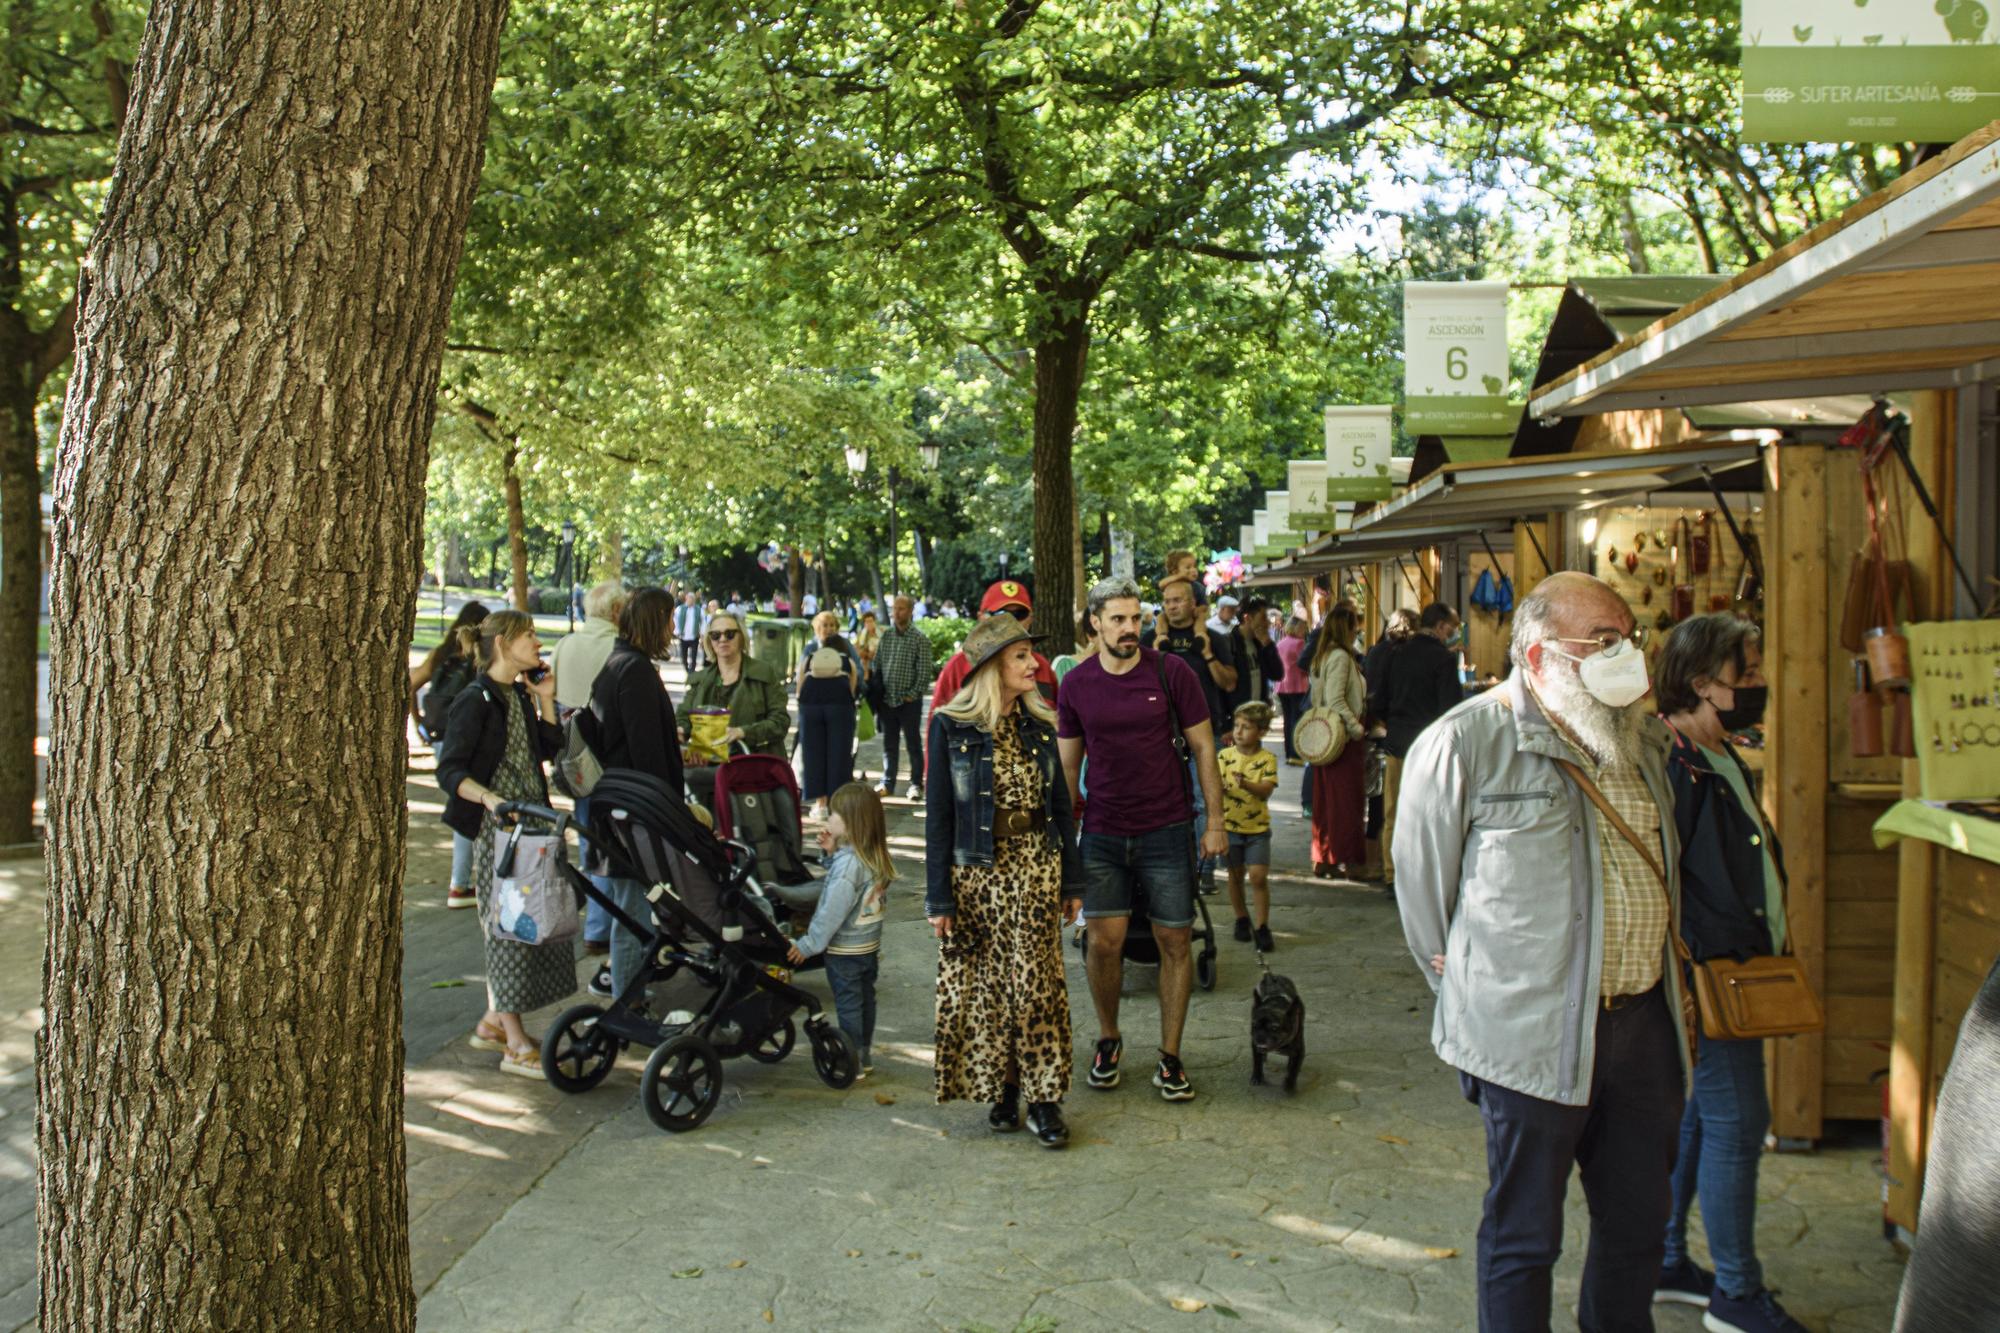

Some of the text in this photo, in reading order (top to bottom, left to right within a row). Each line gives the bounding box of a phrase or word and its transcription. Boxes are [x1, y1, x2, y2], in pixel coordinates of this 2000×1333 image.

[1800, 82, 1941, 103] SUFER ARTESANÍA
[1429, 323, 1484, 335] ASCENSIÓN
[1446, 346, 1468, 381] 6
[1352, 446, 1366, 468] 5
[1308, 489, 1318, 506] 4
